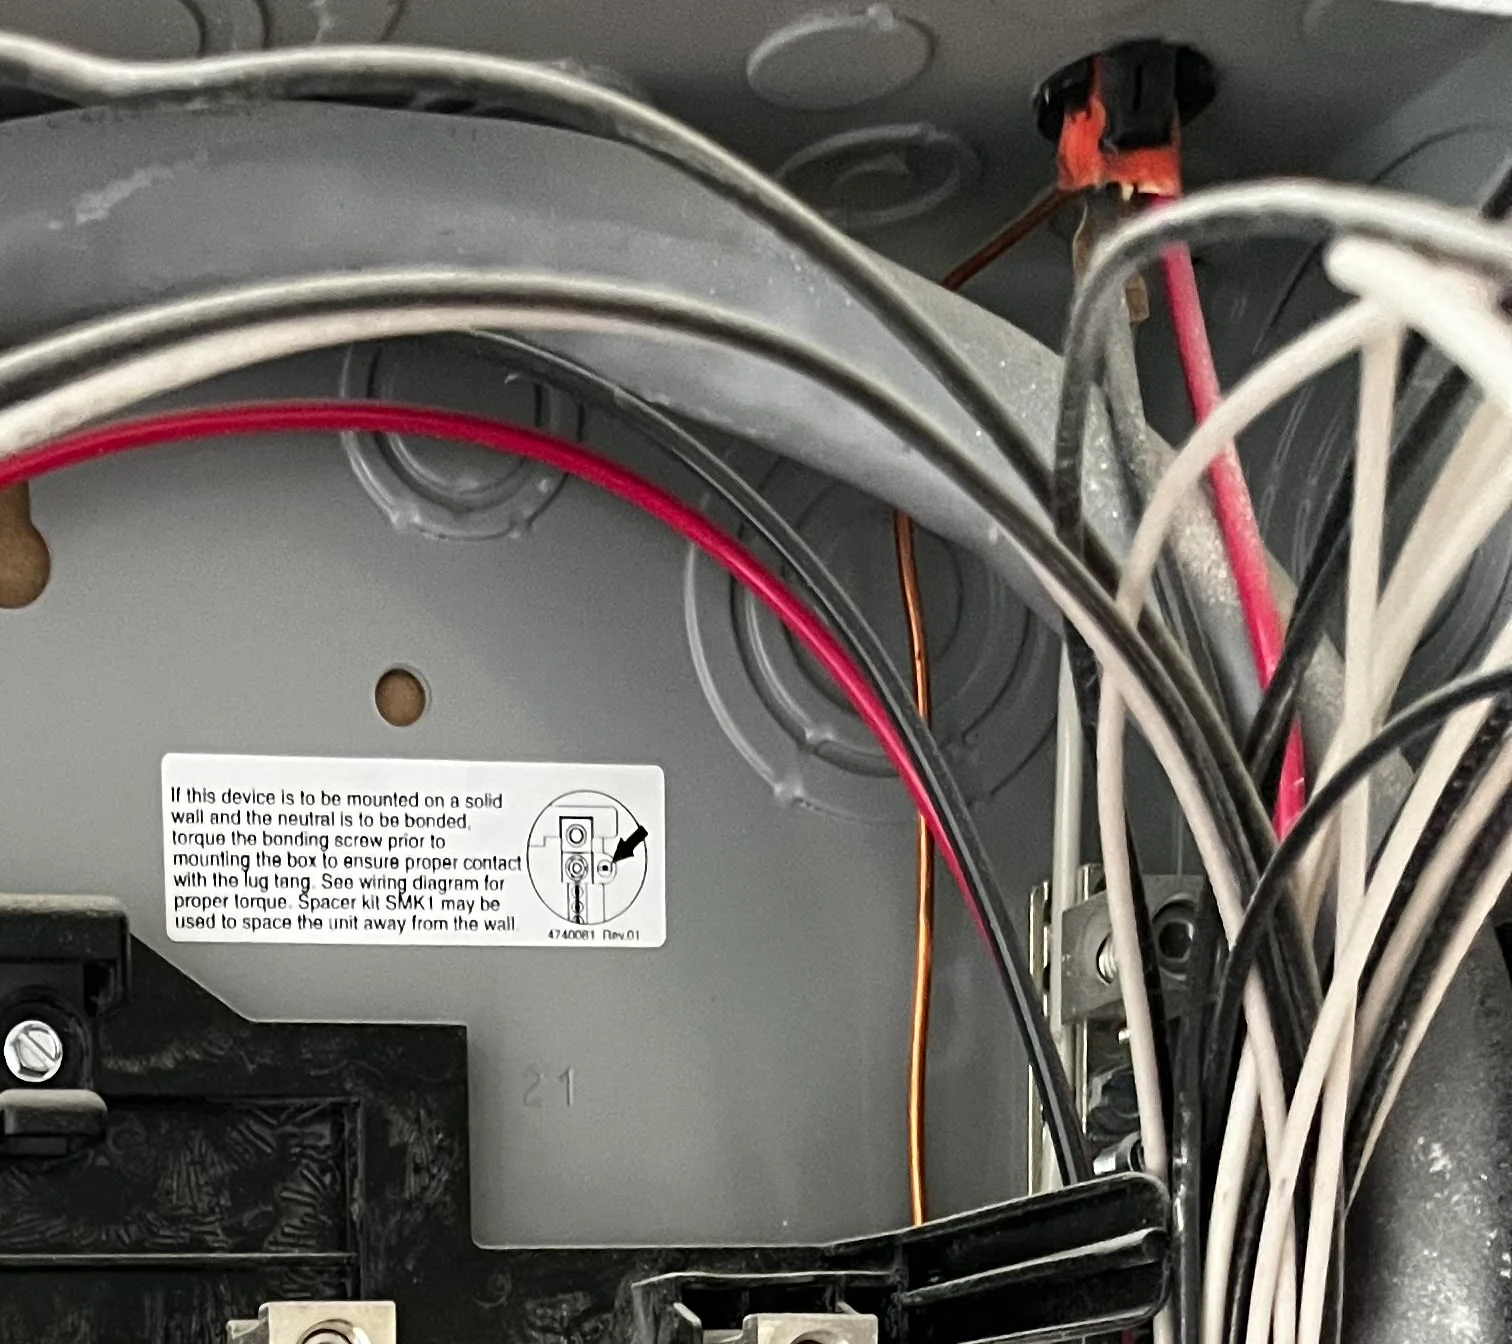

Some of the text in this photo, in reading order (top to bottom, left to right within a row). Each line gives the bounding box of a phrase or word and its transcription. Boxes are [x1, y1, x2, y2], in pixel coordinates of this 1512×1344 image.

[171, 786, 503, 809] If this device is to be mounted on a solid
[171, 809, 204, 825] wall
[210, 810, 241, 825] and
[247, 810, 272, 826] the
[278, 811, 335, 826] neutral
[341, 812, 353, 827] is
[359, 812, 373, 827] to
[380, 813, 399, 828] be
[172, 830, 446, 852] torque the bonding screw prior to
[173, 851, 522, 874] mounting the box to ensure proper contact
[173, 872, 207, 887] with
[212, 872, 238, 888] the
[244, 871, 269, 892] lug
[321, 873, 354, 890] See
[359, 875, 407, 894] wiring
[412, 875, 479, 895] diagram
[484, 875, 505, 891] for
[174, 895, 229, 912] proper
[298, 893, 356, 913] Spacer
[362, 895, 380, 910] kit
[441, 898, 475, 914] may
[480, 896, 501, 911] be
[175, 913, 215, 929] used
[221, 913, 236, 929] to
[242, 917, 292, 933] space
[297, 914, 323, 930] the
[329, 915, 358, 930] unit
[364, 919, 406, 935] away
[412, 915, 448, 931] from
[453, 916, 478, 931] the
[522, 1064, 576, 1108] 21
